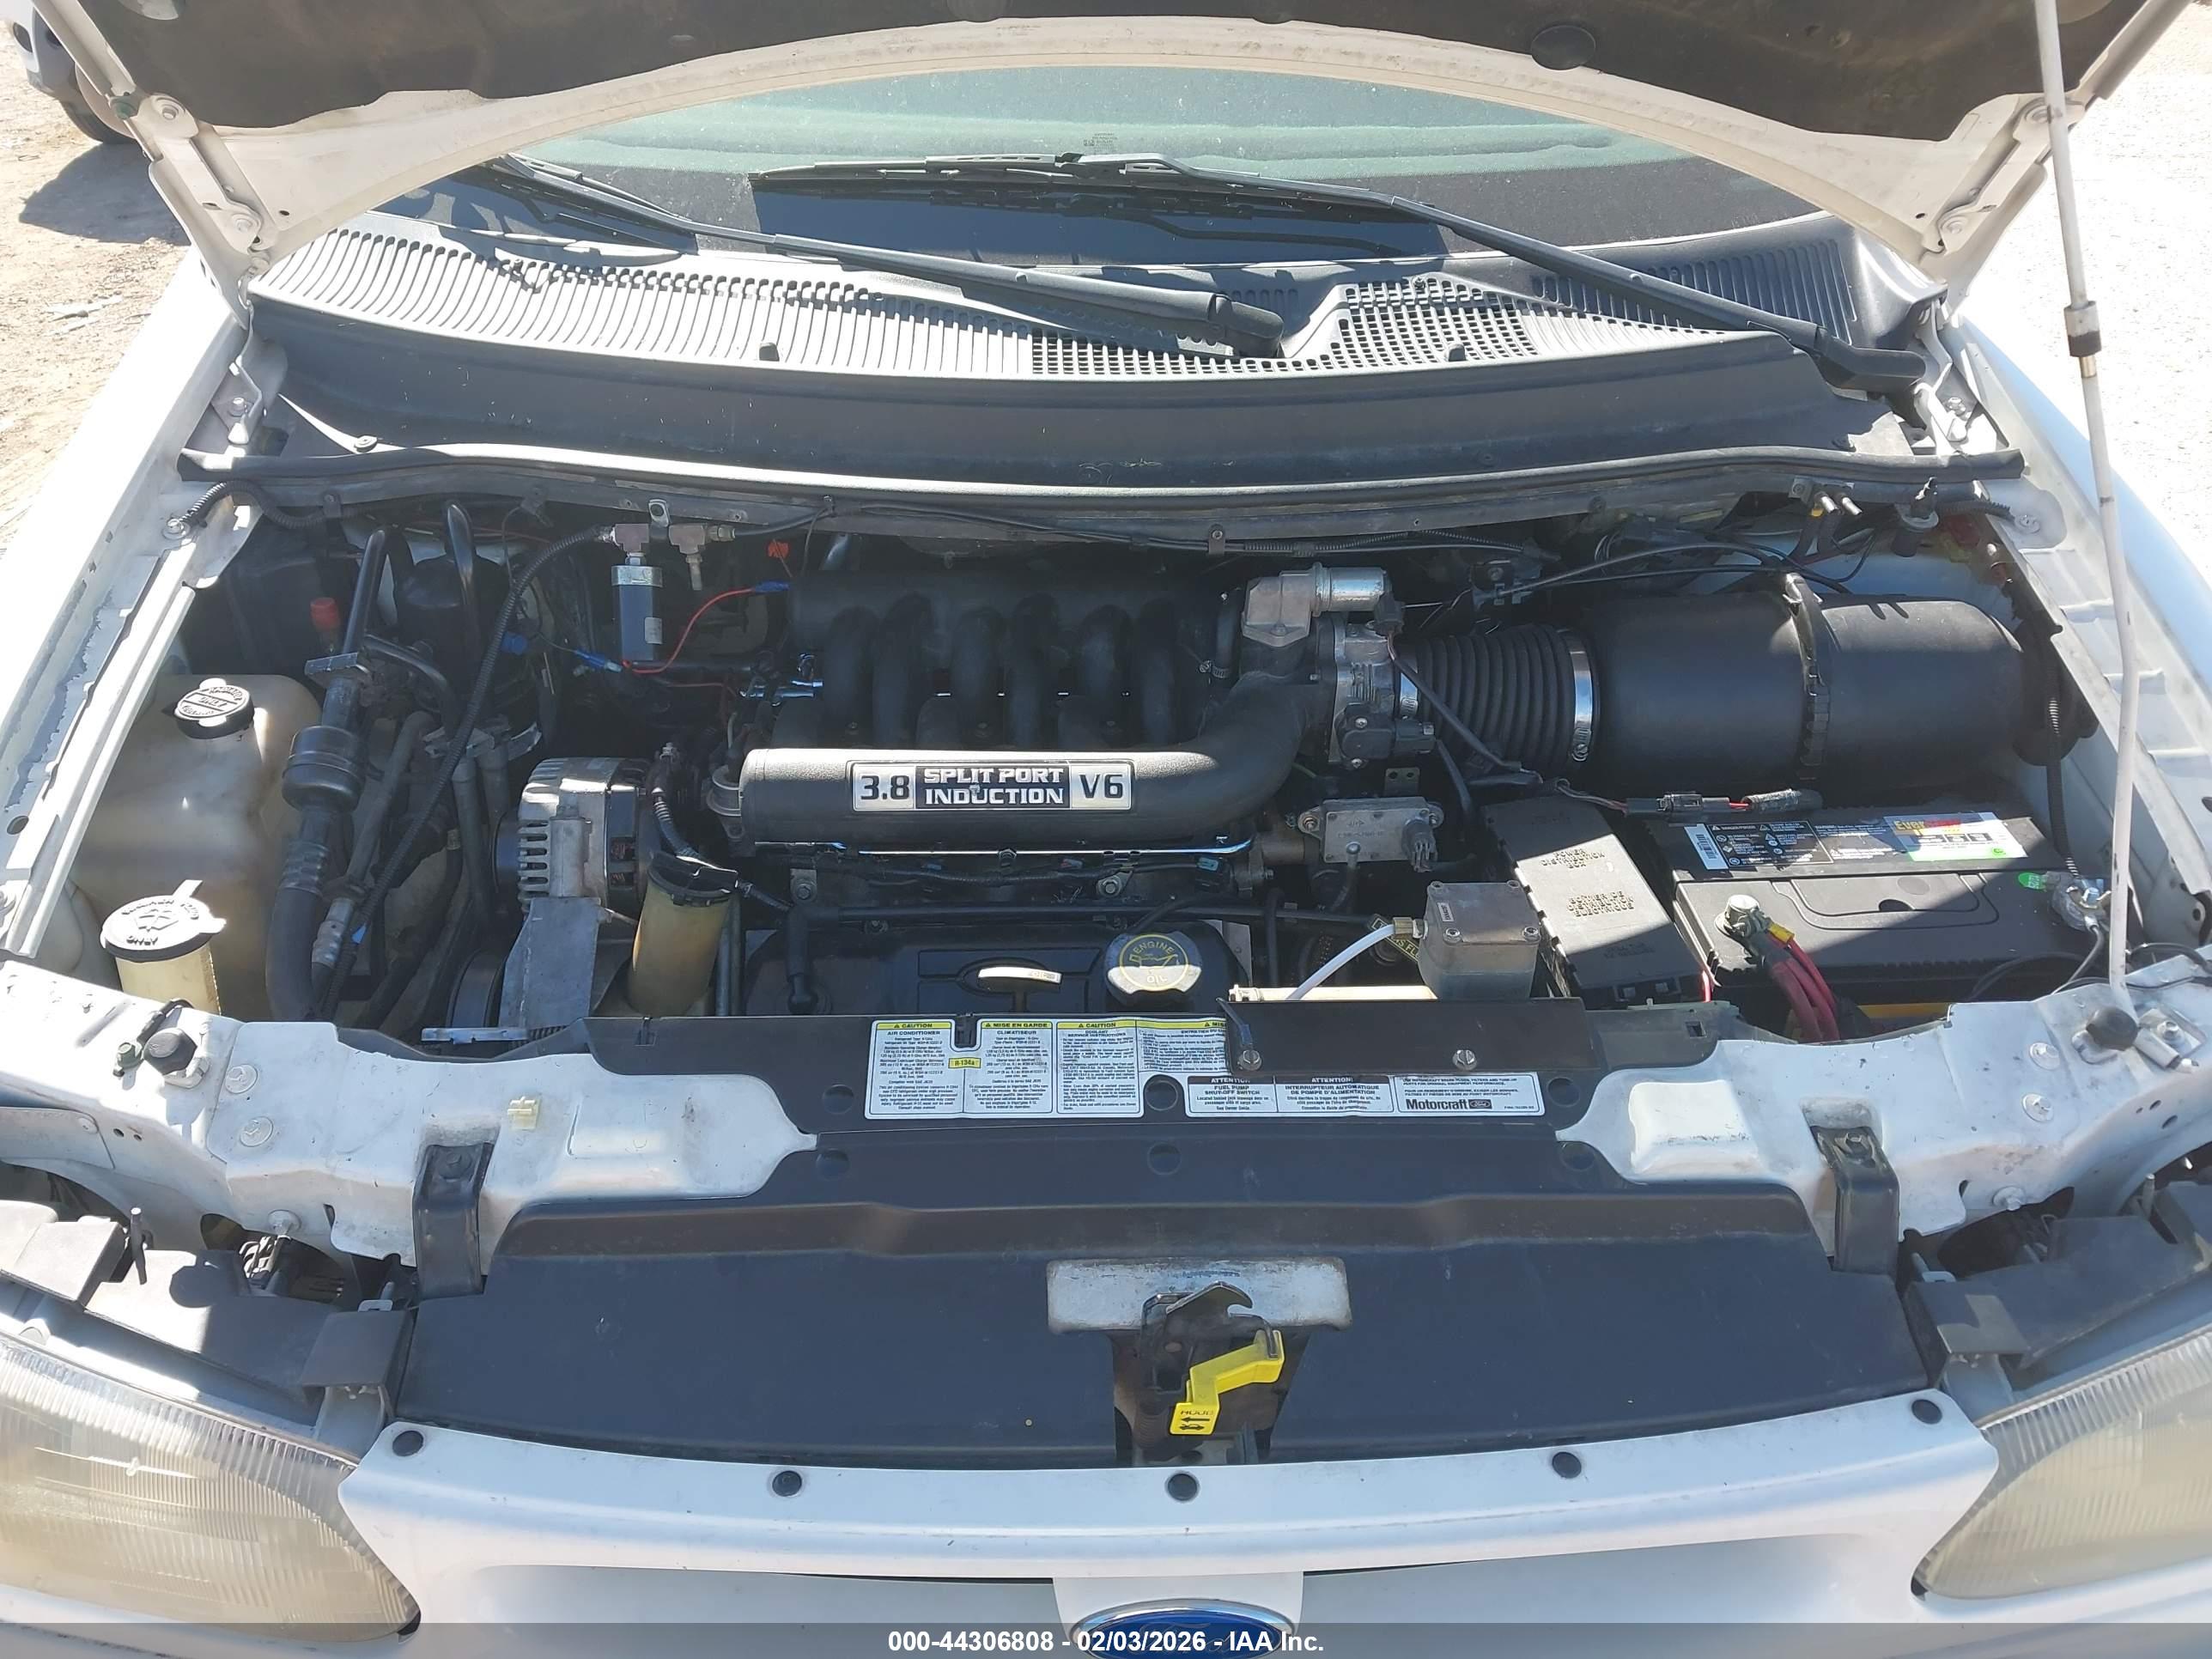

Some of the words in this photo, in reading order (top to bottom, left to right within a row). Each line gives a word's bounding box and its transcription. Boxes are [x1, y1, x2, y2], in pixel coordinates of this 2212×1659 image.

[923, 768, 993, 783] SPLIT
[999, 768, 1062, 783] PORT
[860, 775, 909, 799] 3.8
[1079, 774, 1123, 799] V6
[925, 788, 1064, 805] INDUCTION
[1133, 941, 1175, 954] ENGINE
[1146, 975, 1168, 984] OIL
[1406, 1098, 1468, 1110] Motorcraft
